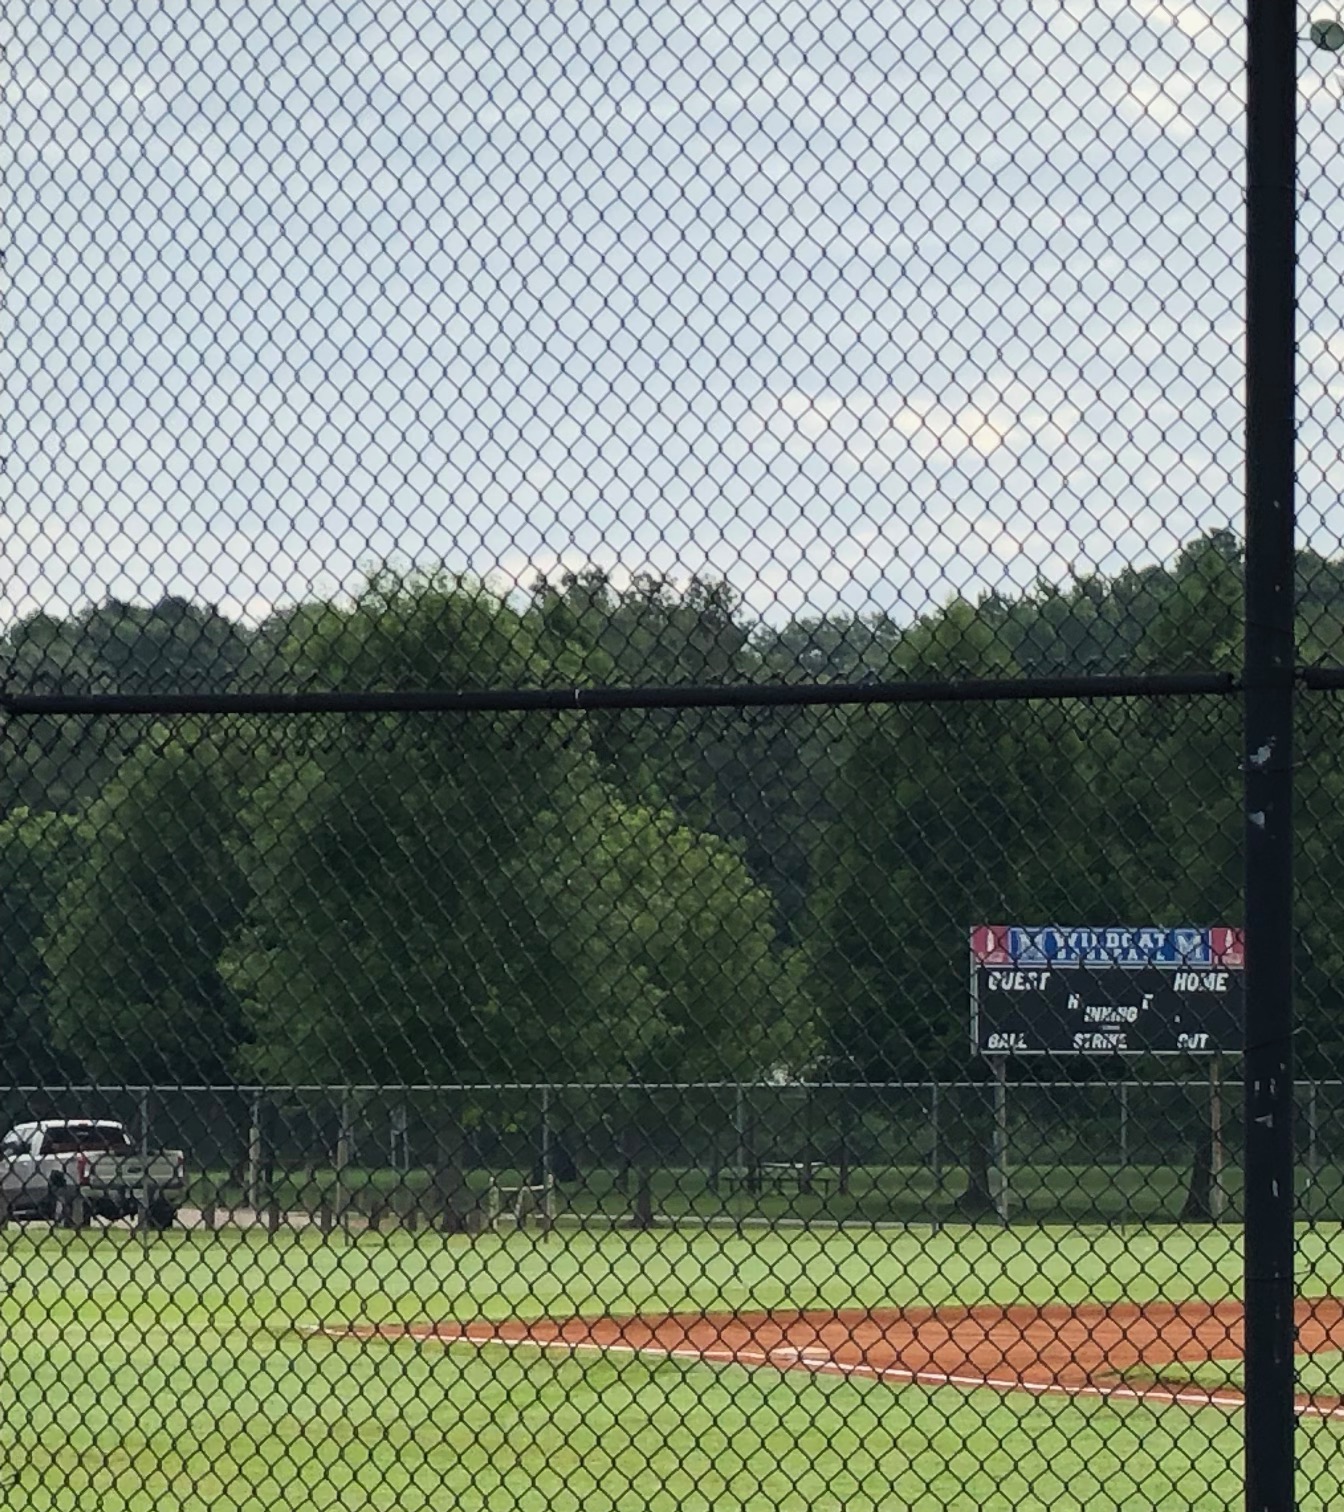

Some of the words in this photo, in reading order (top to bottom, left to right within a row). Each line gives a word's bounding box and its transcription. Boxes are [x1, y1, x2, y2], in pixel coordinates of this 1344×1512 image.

[988, 971, 1050, 991] GUEST
[1173, 972, 1229, 992] HOME
[1083, 1006, 1138, 1023] INNING
[988, 1033, 1028, 1049] BALL
[1072, 1033, 1128, 1049] STRIKE
[1177, 1033, 1210, 1049] OUT
